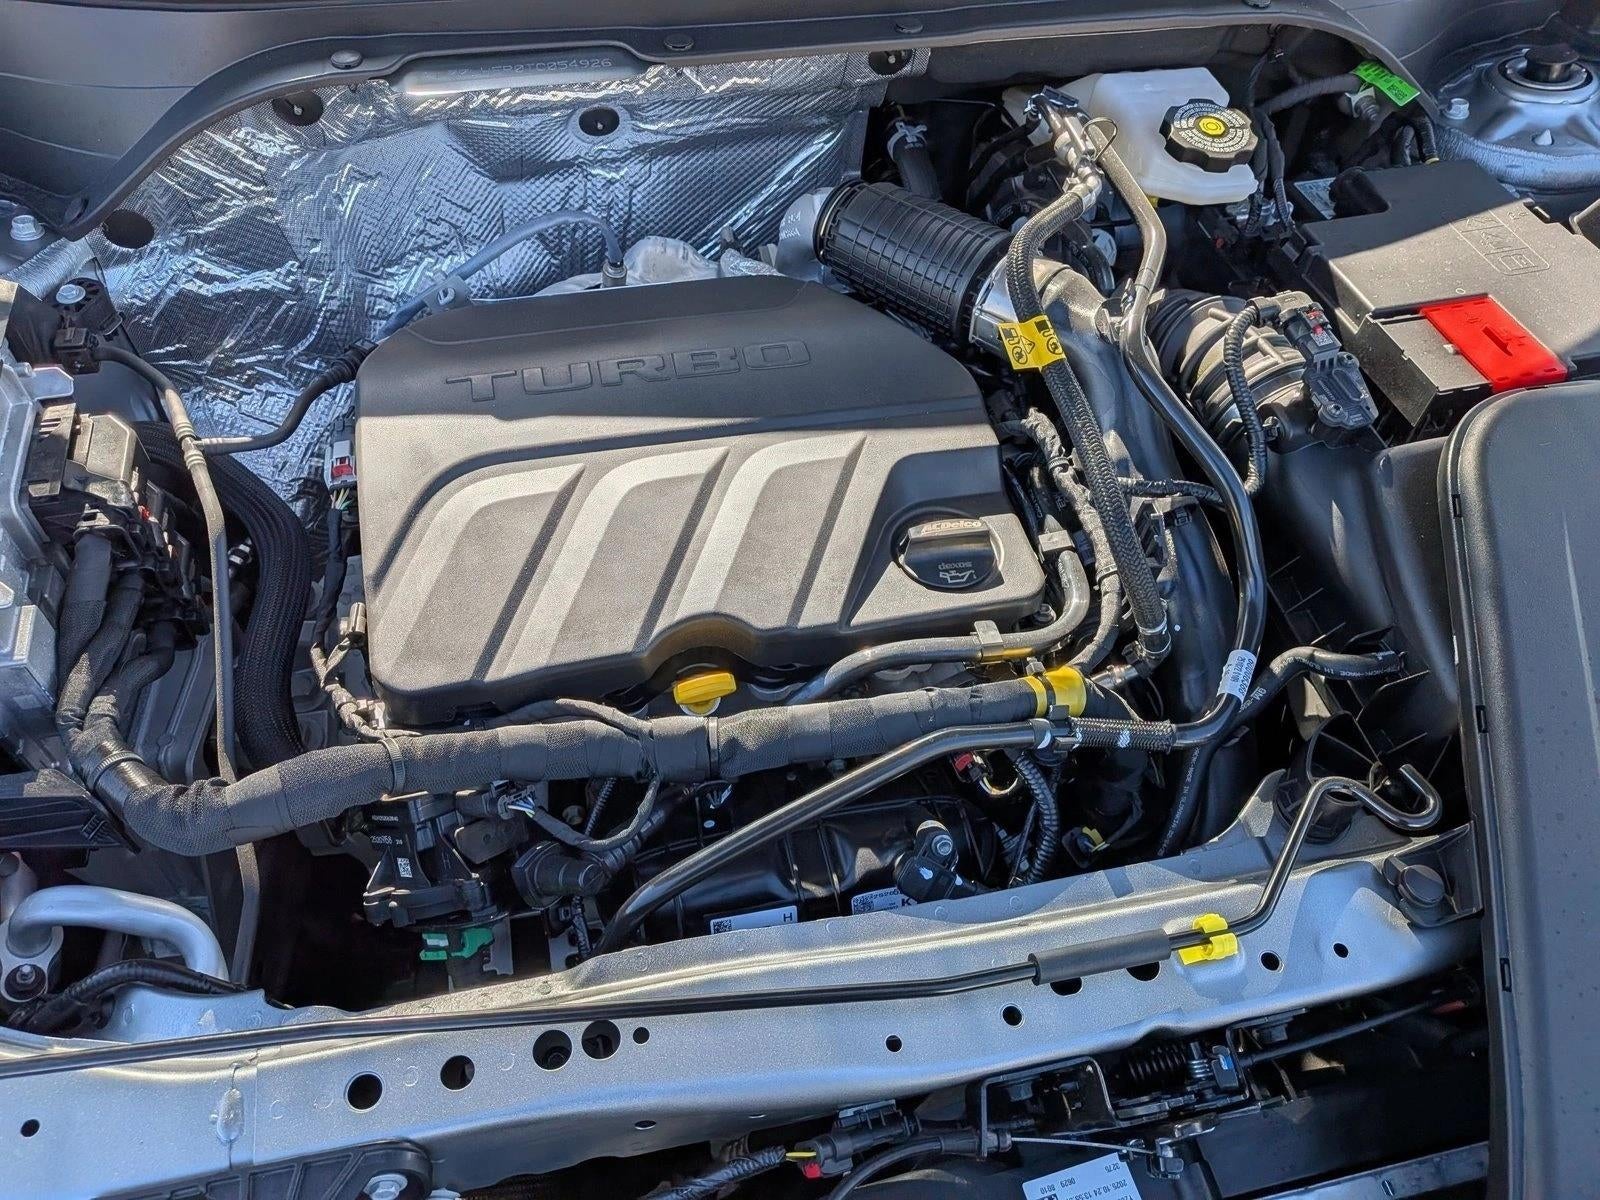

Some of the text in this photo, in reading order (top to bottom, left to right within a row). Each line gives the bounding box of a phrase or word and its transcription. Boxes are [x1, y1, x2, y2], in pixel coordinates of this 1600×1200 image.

[446, 341, 810, 402] TURBO
[921, 519, 982, 535] ACDelco
[938, 561, 973, 570] dexos
[783, 912, 793, 922] H
